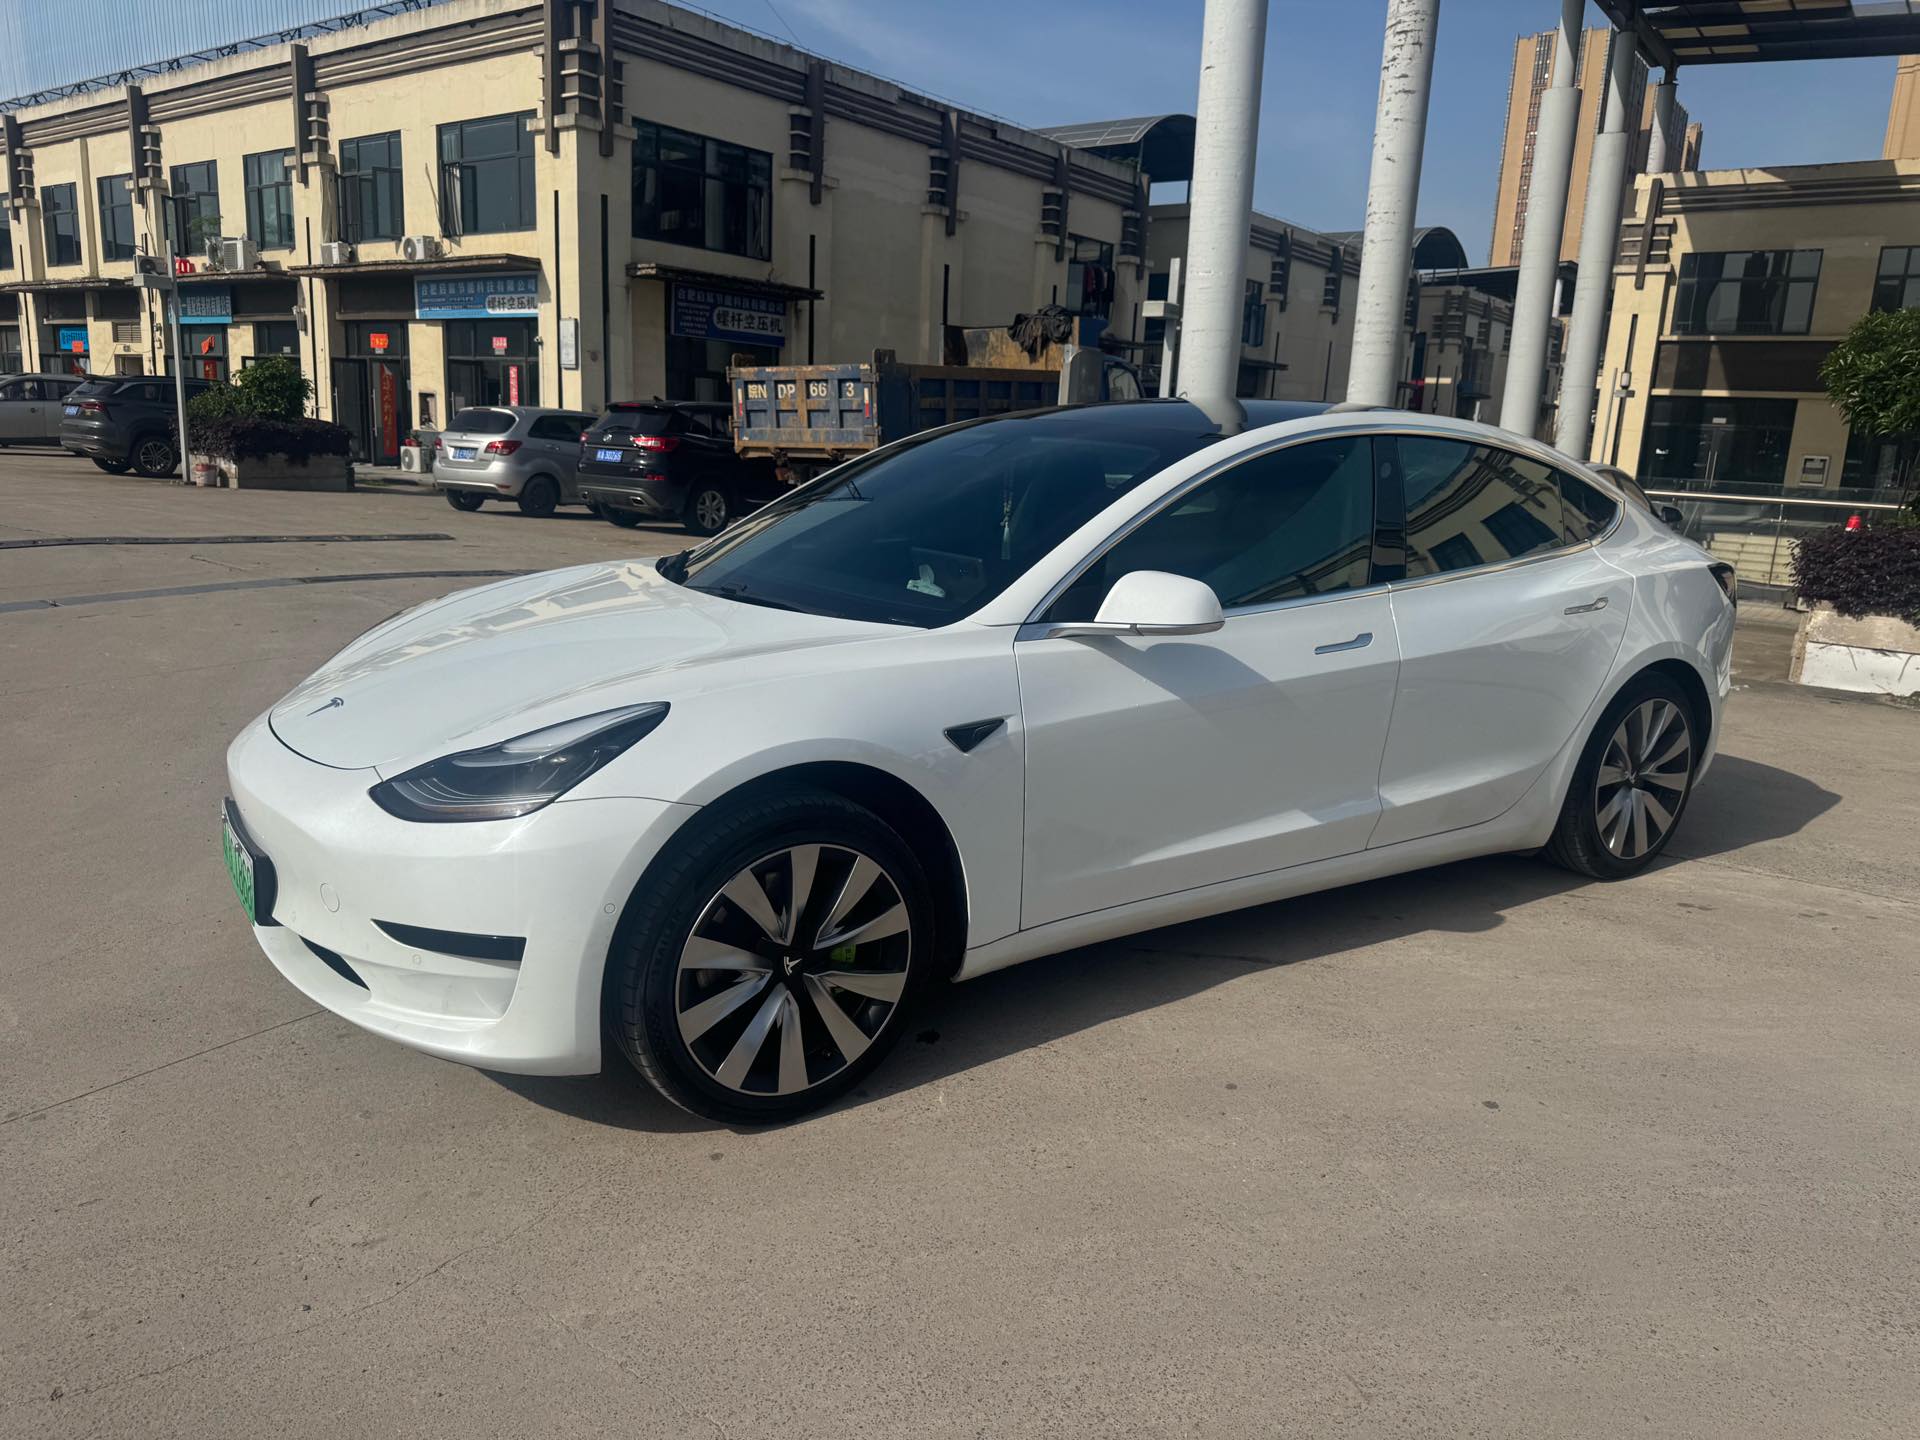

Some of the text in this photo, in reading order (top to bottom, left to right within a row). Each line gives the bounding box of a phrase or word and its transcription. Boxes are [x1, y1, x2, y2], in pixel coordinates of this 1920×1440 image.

[487, 296, 538, 311] 螺杆空压机
[716, 309, 783, 333] 螺杆空压机
